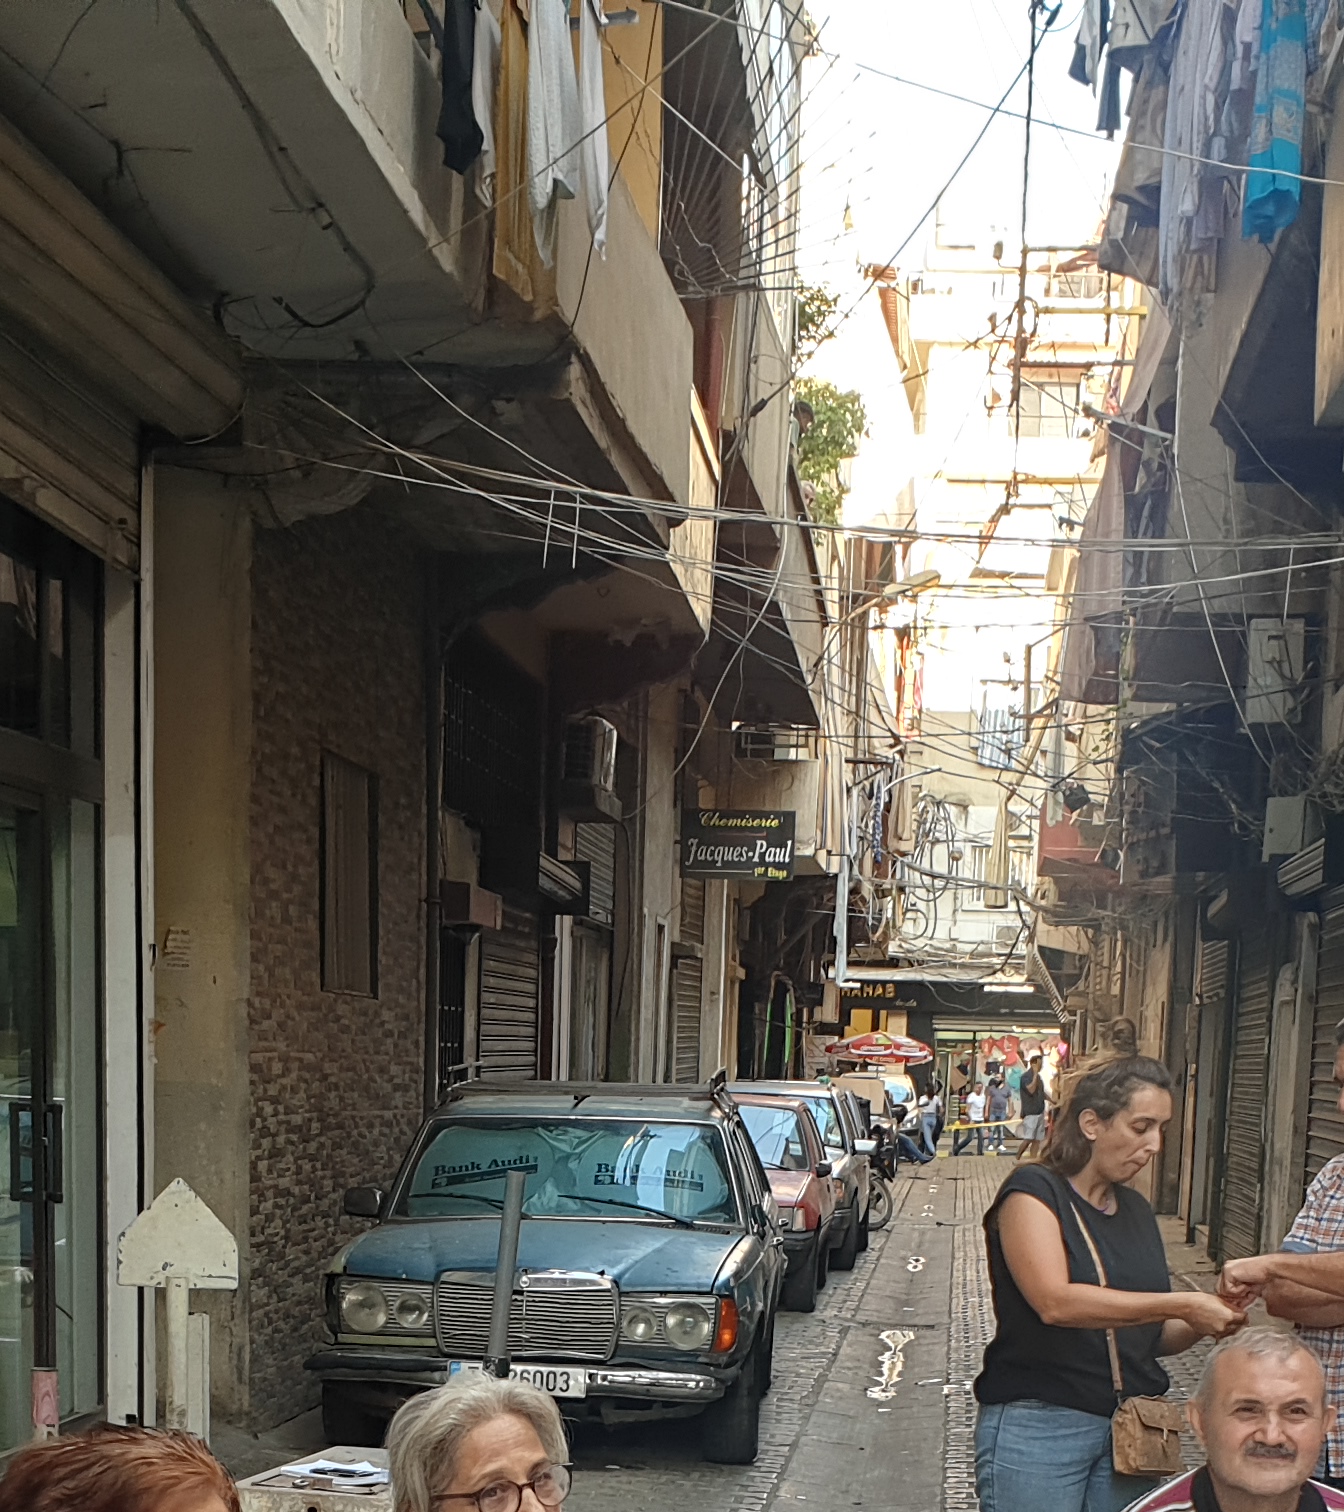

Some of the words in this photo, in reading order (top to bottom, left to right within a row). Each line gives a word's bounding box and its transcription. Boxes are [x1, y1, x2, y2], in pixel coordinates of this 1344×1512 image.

[699, 811, 780, 828] Chemiserie
[685, 838, 793, 867] Jacques-Paul
[434, 1161, 482, 1177] Bank
[487, 1154, 530, 1169] Audi
